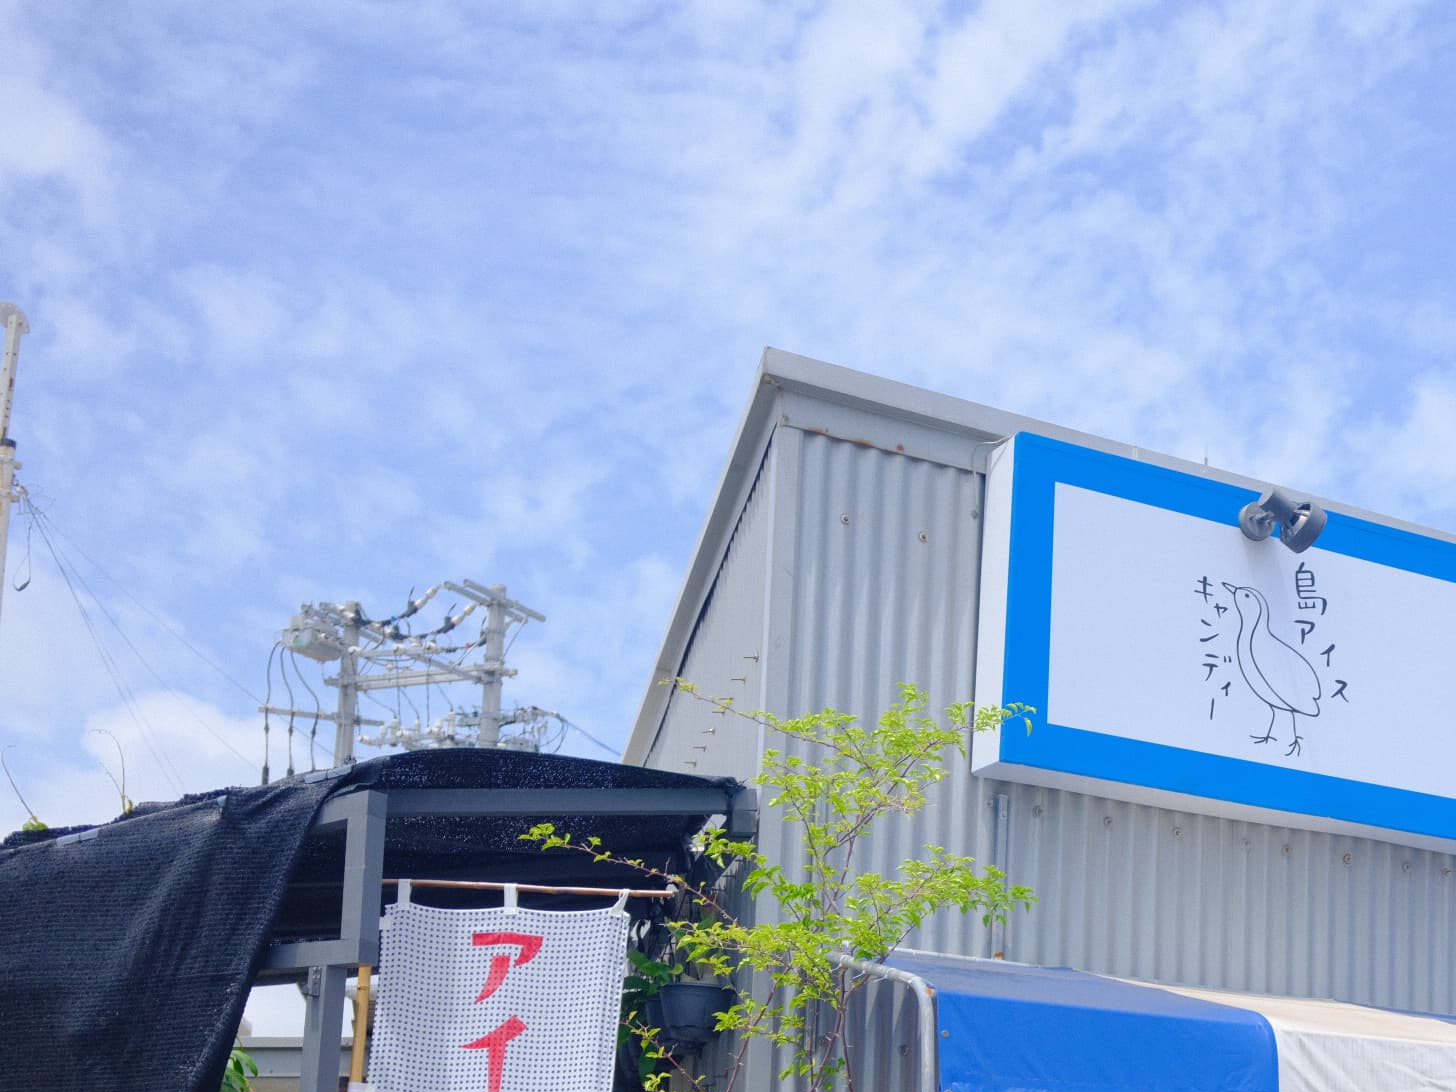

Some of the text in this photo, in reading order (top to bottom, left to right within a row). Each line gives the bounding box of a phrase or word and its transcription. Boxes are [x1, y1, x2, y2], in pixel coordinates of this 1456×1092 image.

[1194, 576, 1233, 720] キャンディー
[1294, 562, 1349, 704] 島アイス
